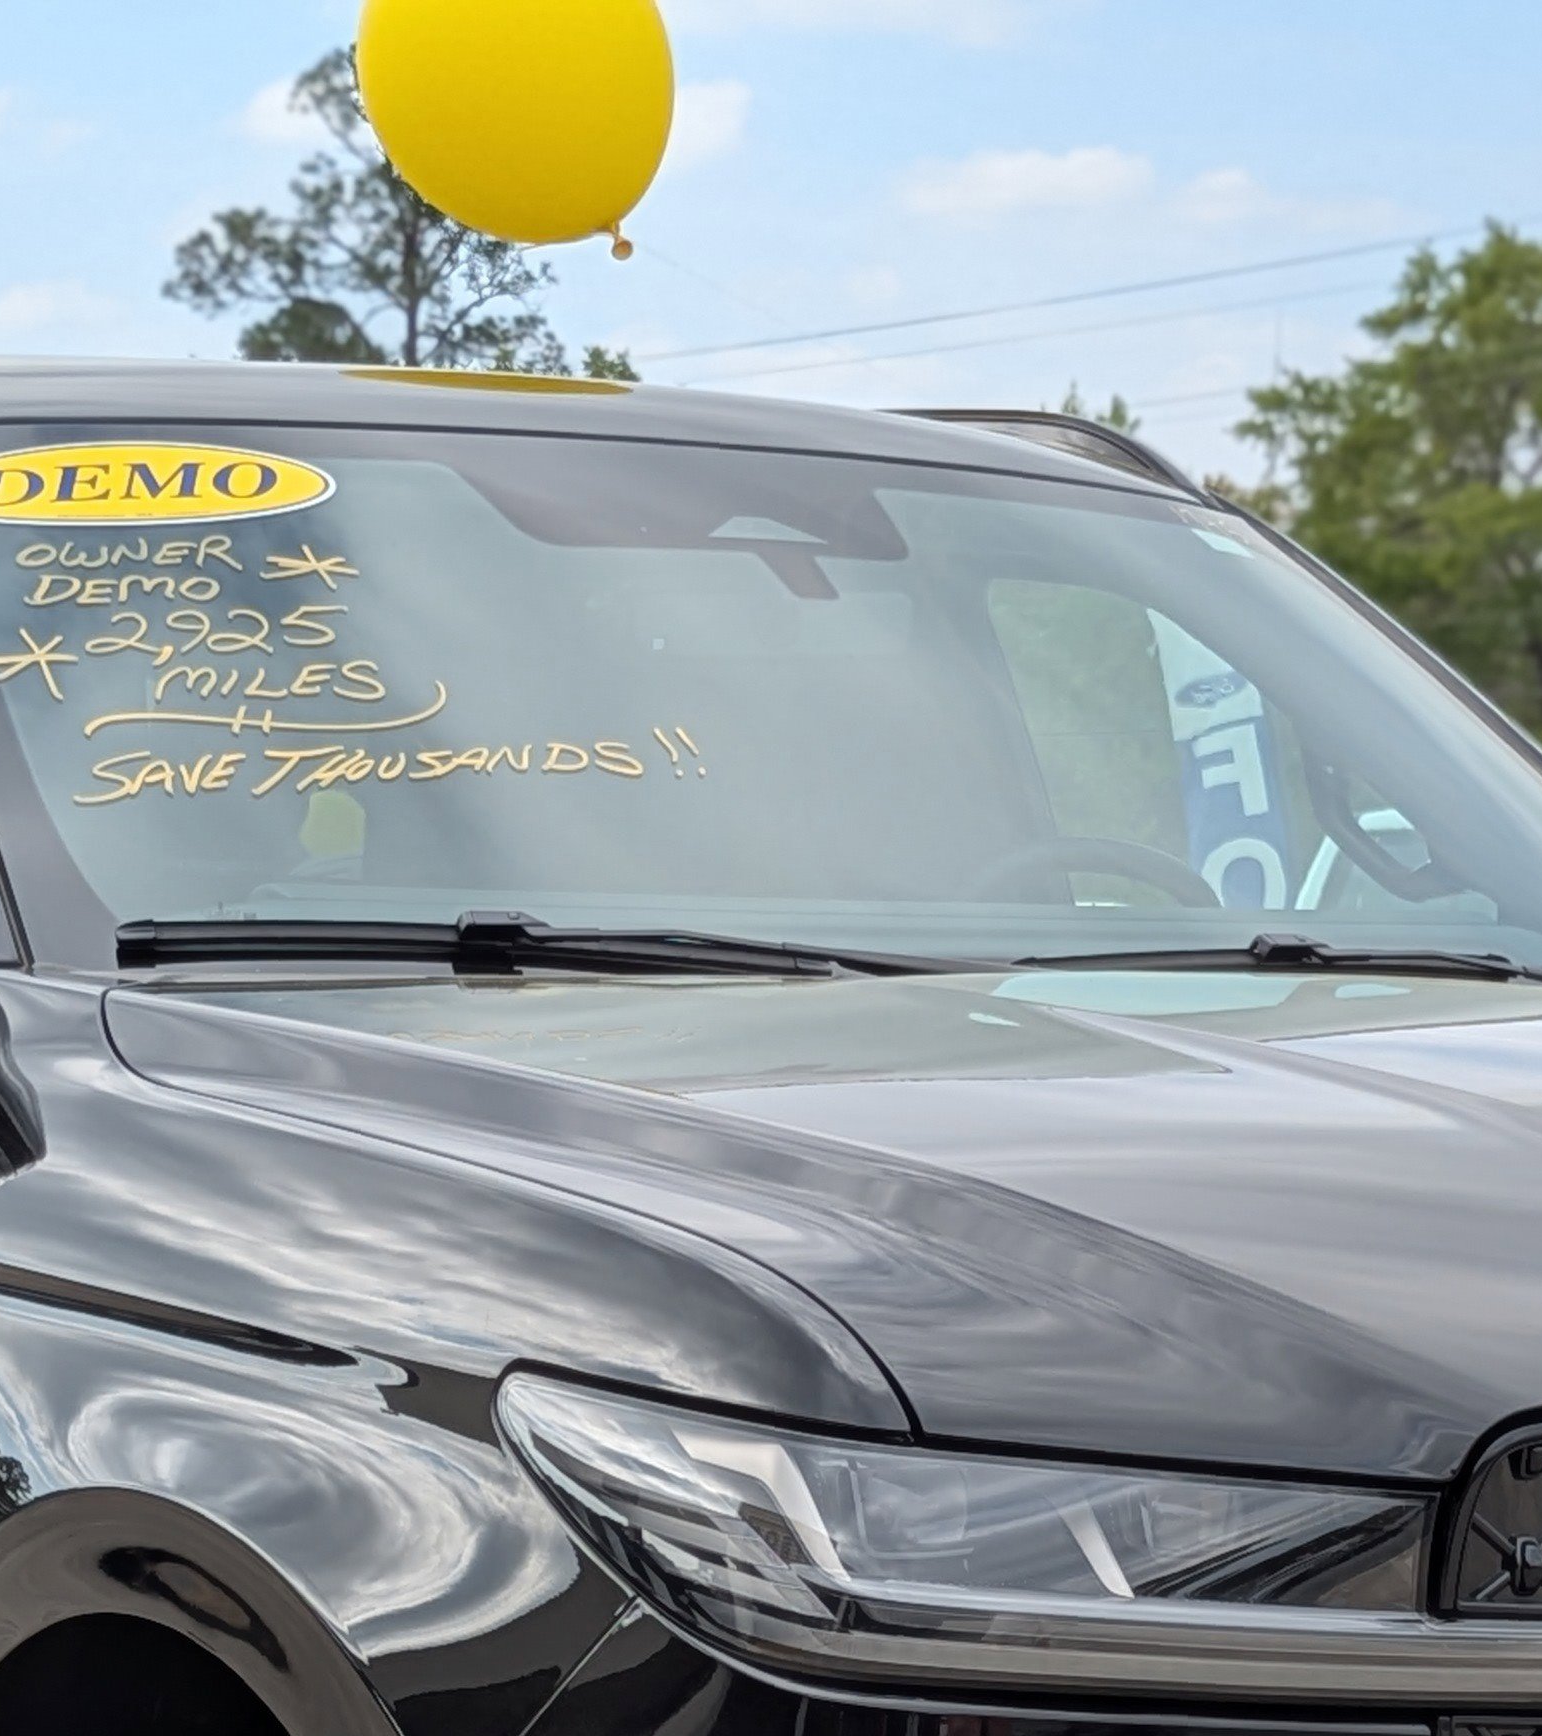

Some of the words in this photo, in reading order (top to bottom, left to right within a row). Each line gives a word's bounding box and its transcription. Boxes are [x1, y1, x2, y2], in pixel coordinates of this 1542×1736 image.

[15, 535, 243, 571] OWNER
[22, 574, 221, 606] DEMO
[84, 605, 349, 666] 2,925
[155, 660, 386, 701] MILES
[73, 749, 247, 804] SAVE
